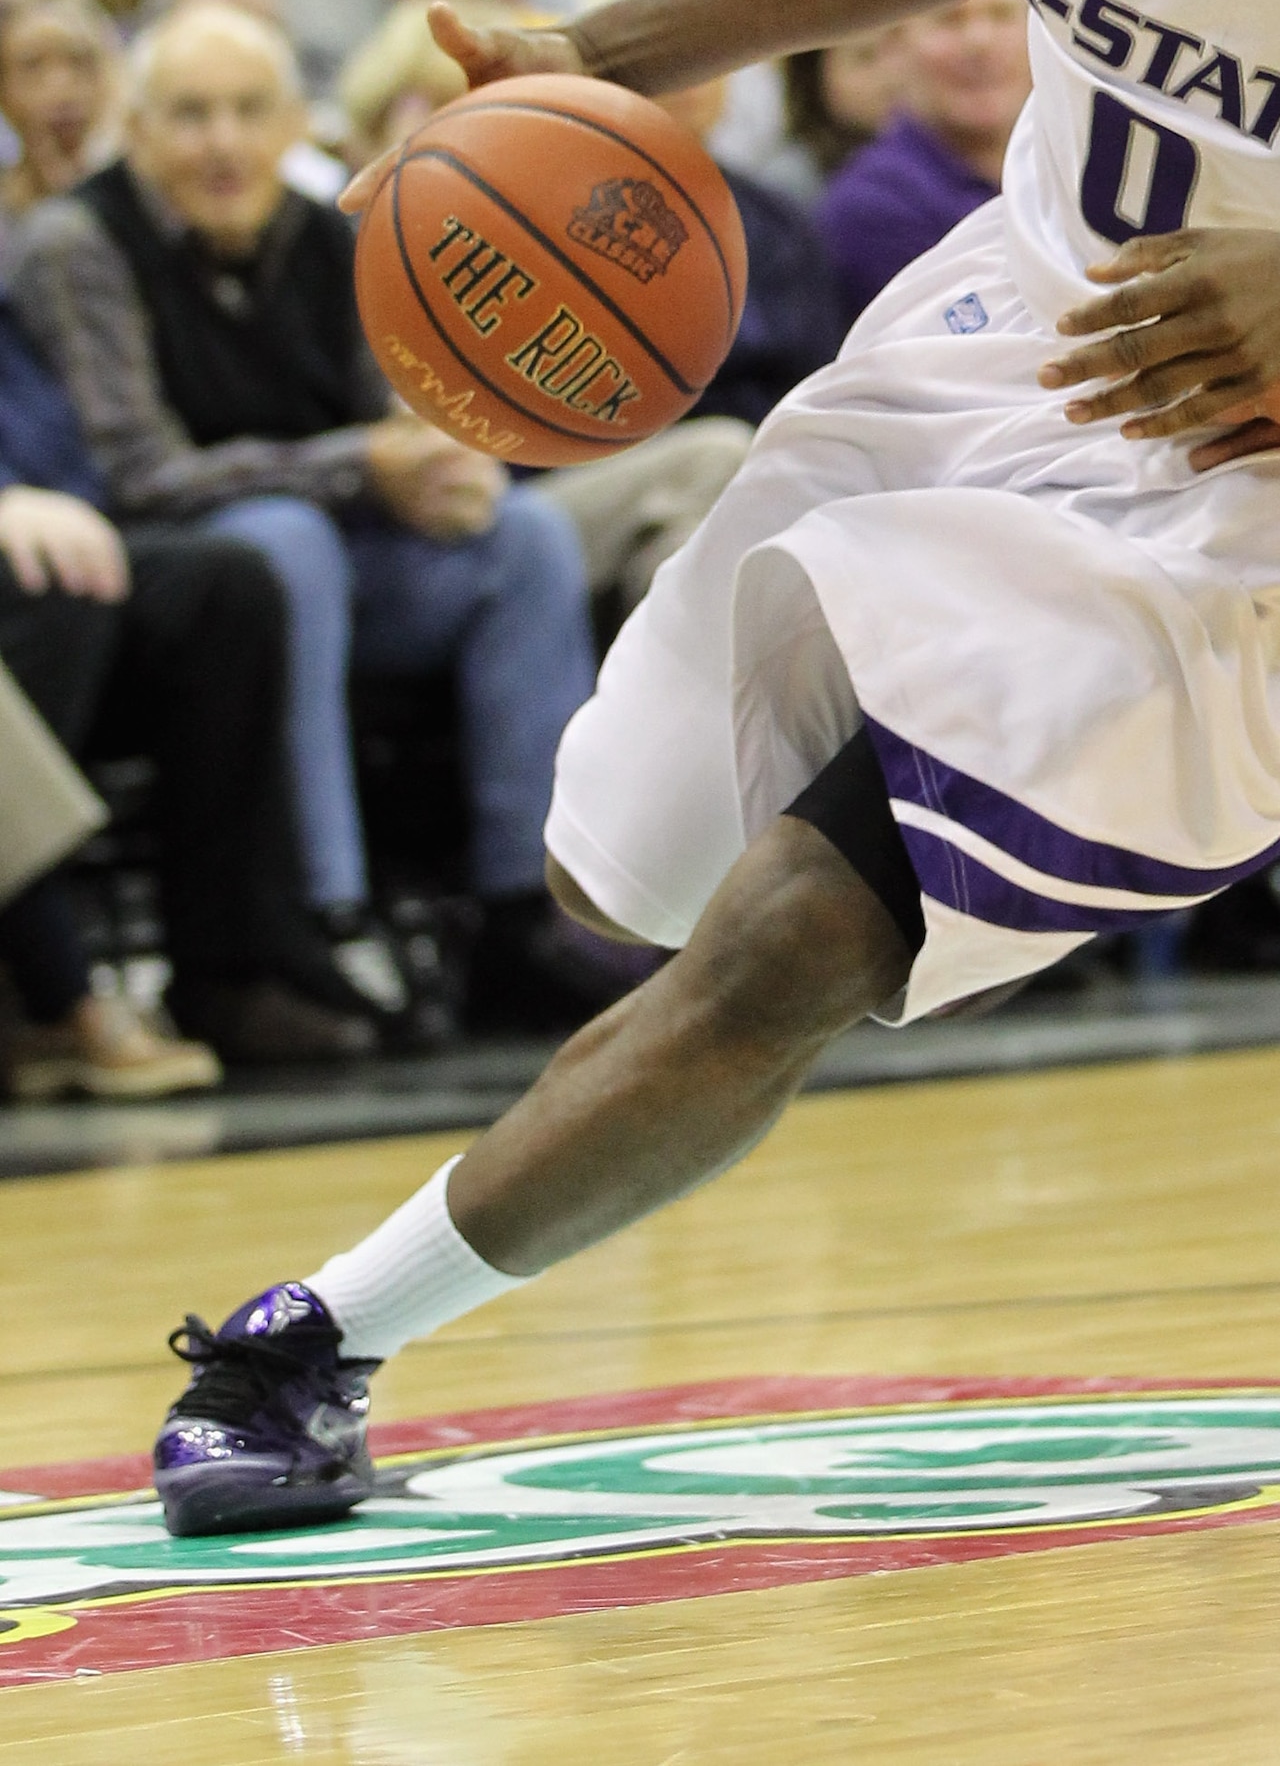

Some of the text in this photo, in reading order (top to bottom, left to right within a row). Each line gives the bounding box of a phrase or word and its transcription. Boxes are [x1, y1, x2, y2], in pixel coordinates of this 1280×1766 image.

[1080, 89, 1202, 247] 0
[428, 215, 540, 338] THE
[505, 302, 641, 422] ROCK
